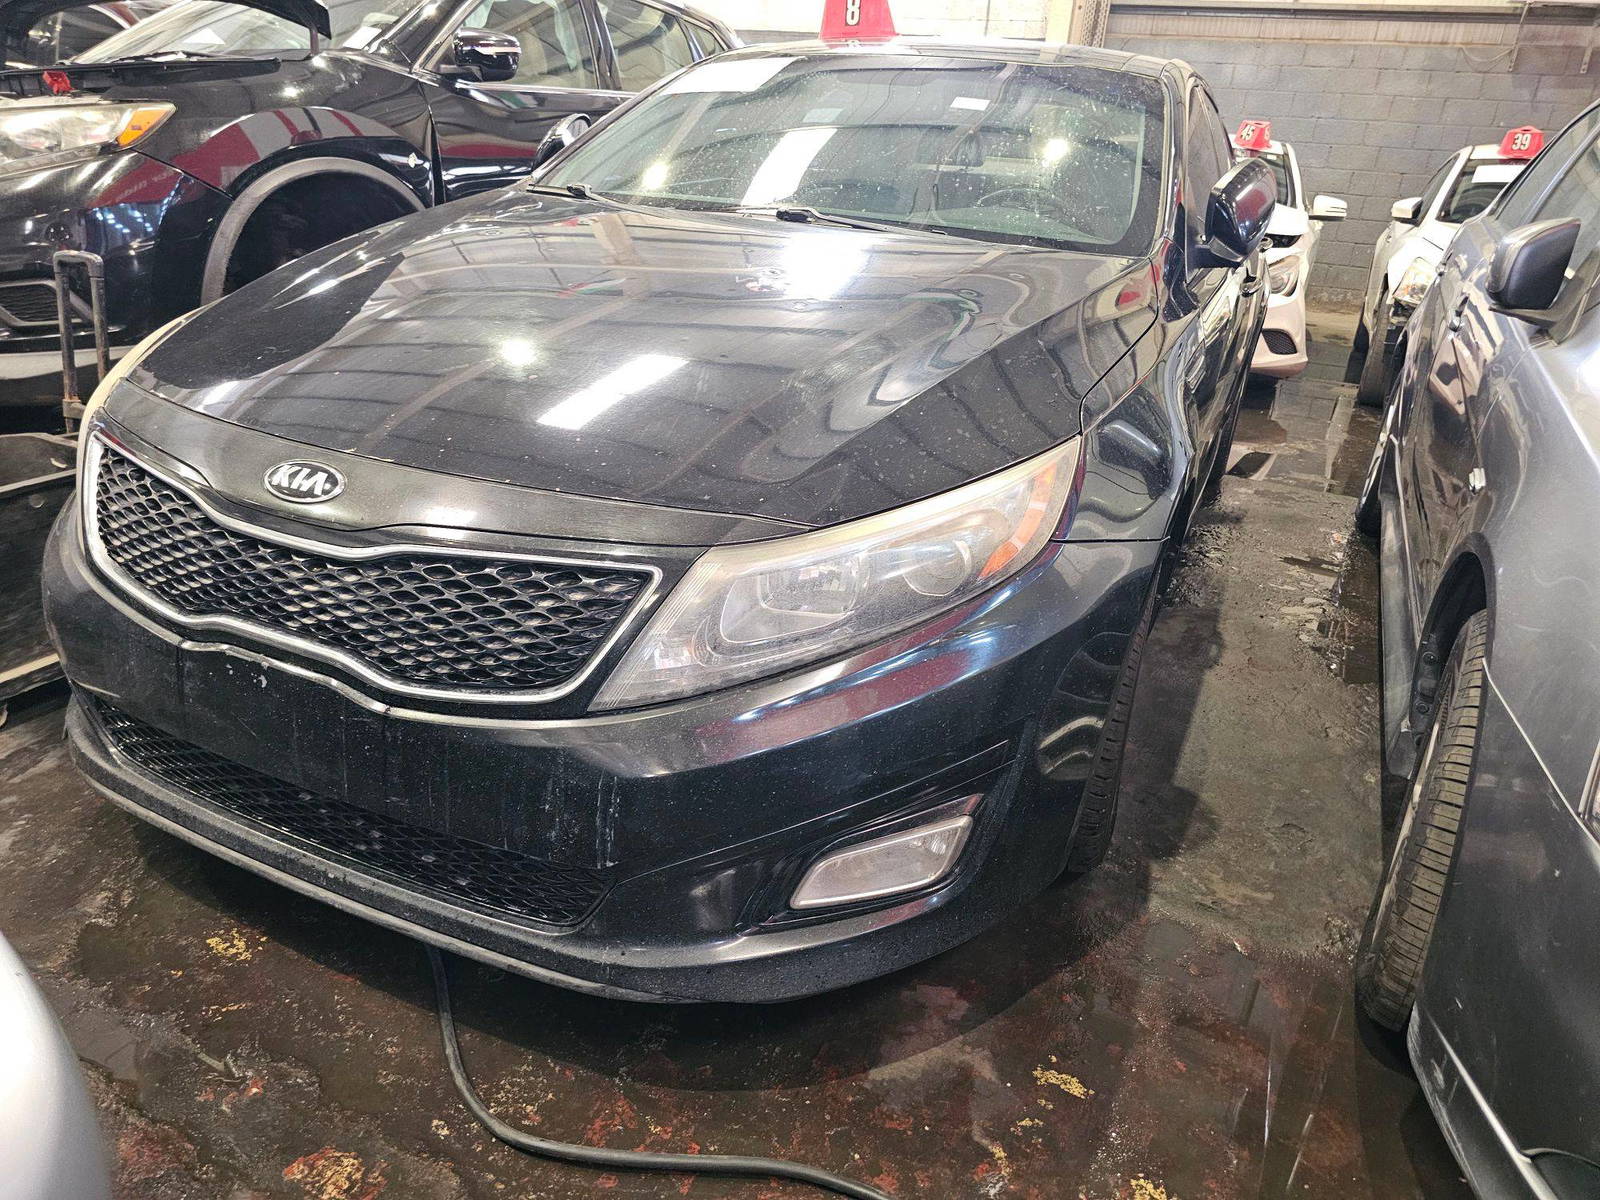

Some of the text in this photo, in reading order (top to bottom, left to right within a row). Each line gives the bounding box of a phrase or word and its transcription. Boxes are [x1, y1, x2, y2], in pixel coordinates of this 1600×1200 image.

[846, 0, 860, 26] 8
[1240, 124, 1257, 141] 45
[1511, 133, 1531, 151] 39
[271, 464, 328, 496] KIA
